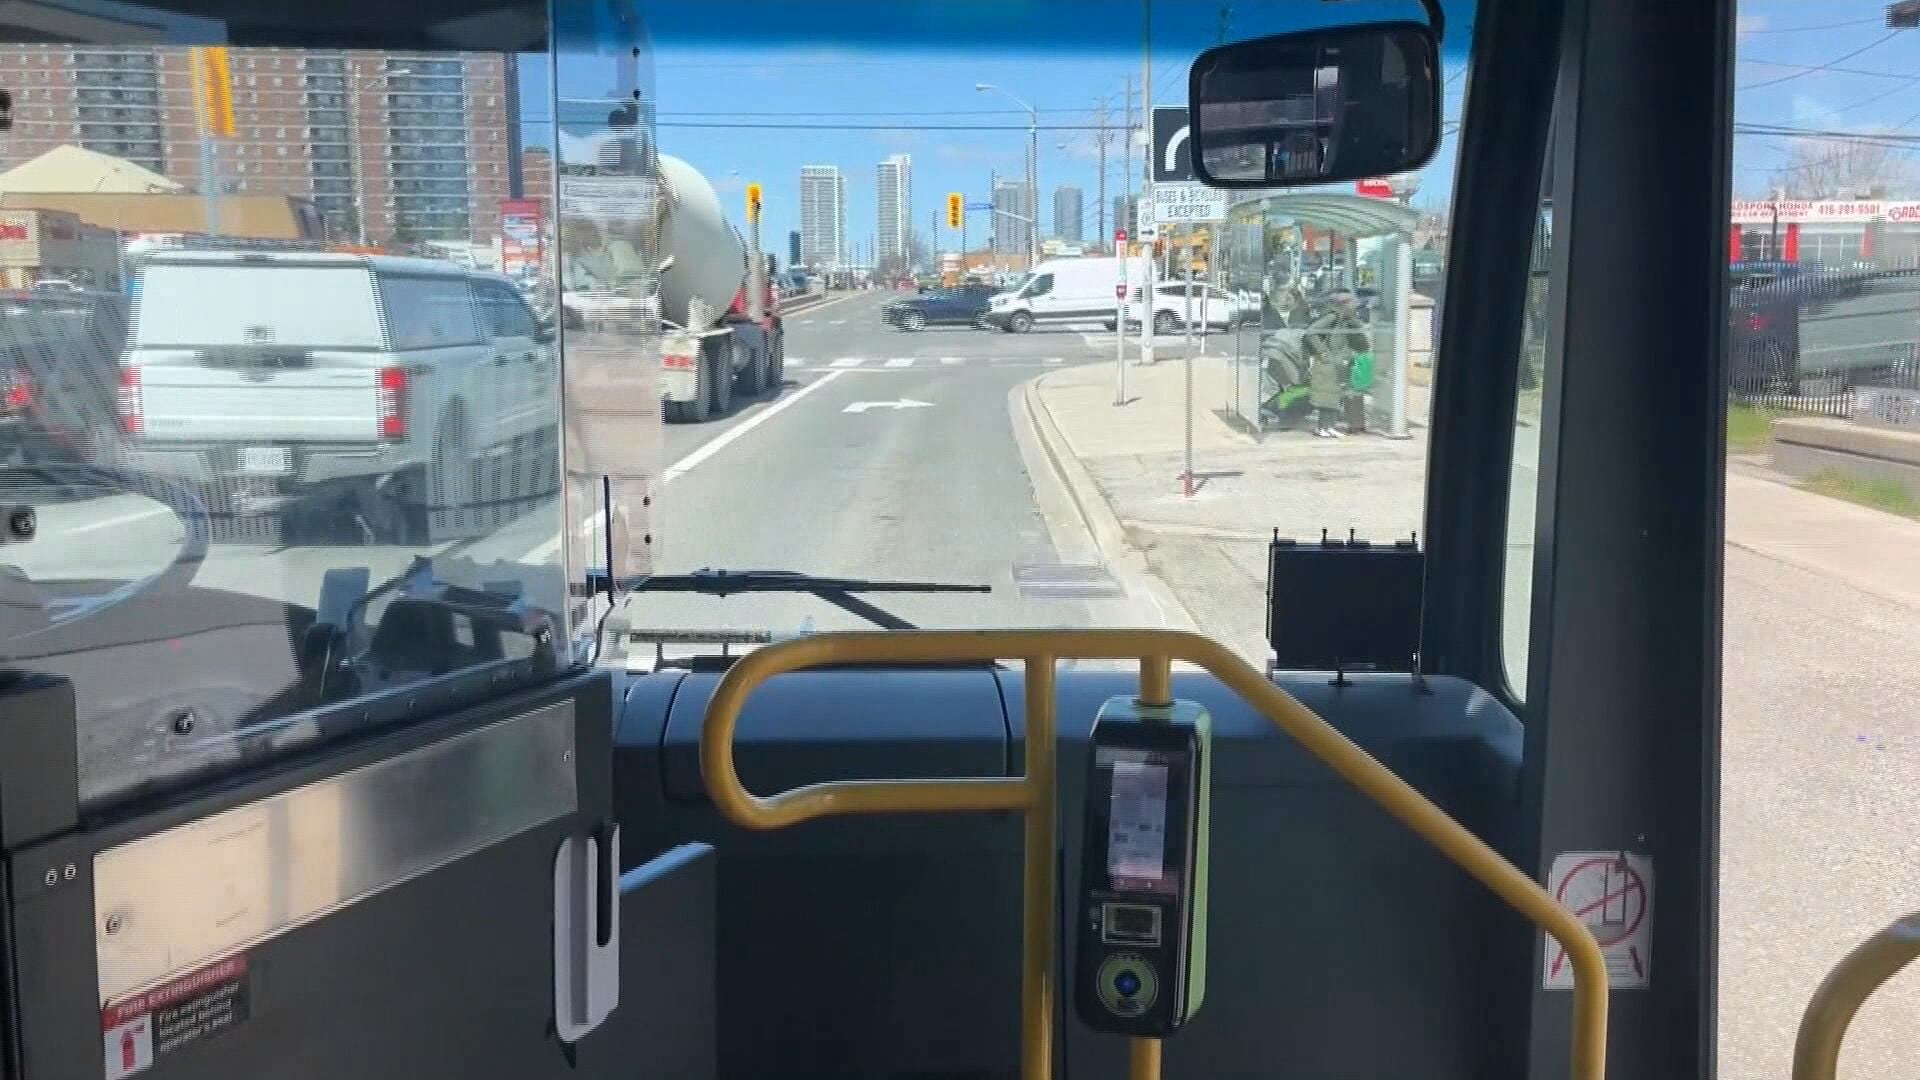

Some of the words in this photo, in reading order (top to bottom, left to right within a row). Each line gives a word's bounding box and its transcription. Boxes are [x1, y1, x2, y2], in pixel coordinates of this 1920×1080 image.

[1155, 190, 1177, 204] BUSES
[1179, 190, 1186, 203] &
[1188, 190, 1224, 204] BICYCLES
[1168, 204, 1211, 217] EXCEPTED
[1779, 201, 1813, 211] HONDA
[117, 998, 146, 1019] FIRE
[149, 963, 235, 1010] EXTINGUISHER
[159, 1010, 179, 1026] Fire
[180, 983, 239, 1014] extinguisher
[159, 1013, 196, 1038] located
[198, 999, 232, 1020] behind
[159, 1024, 211, 1054] operator's
[212, 1011, 233, 1028] seat
